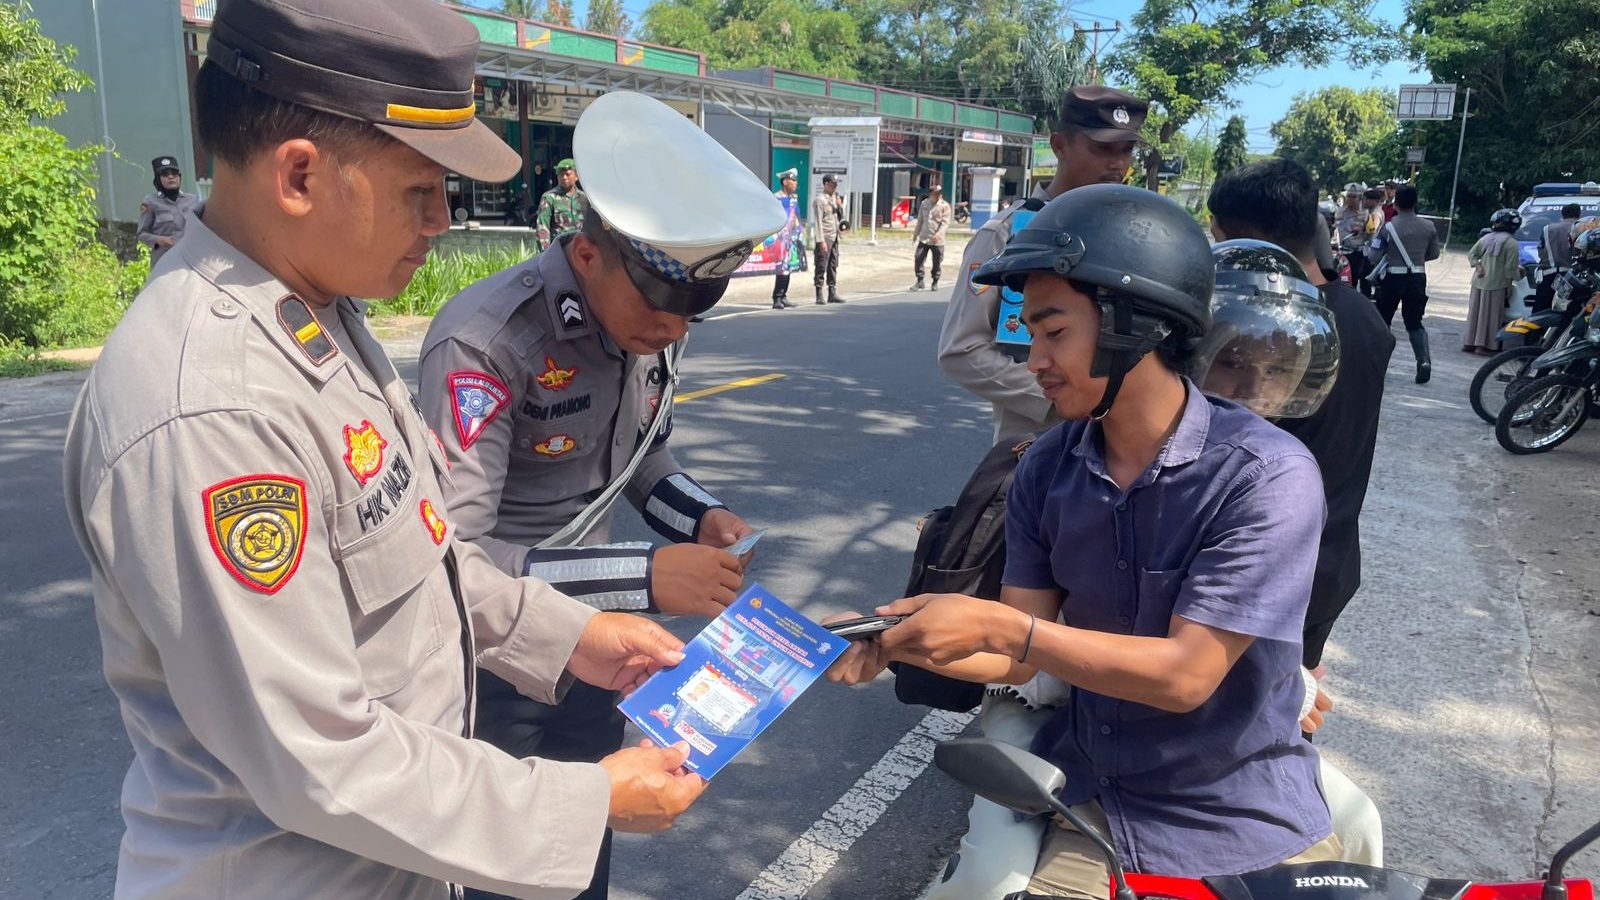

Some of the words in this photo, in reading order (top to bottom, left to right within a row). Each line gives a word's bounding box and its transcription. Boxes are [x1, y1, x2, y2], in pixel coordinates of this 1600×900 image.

[218, 489, 253, 509] SDM
[357, 489, 390, 533] HK
[1295, 876, 1369, 888] HONDA
